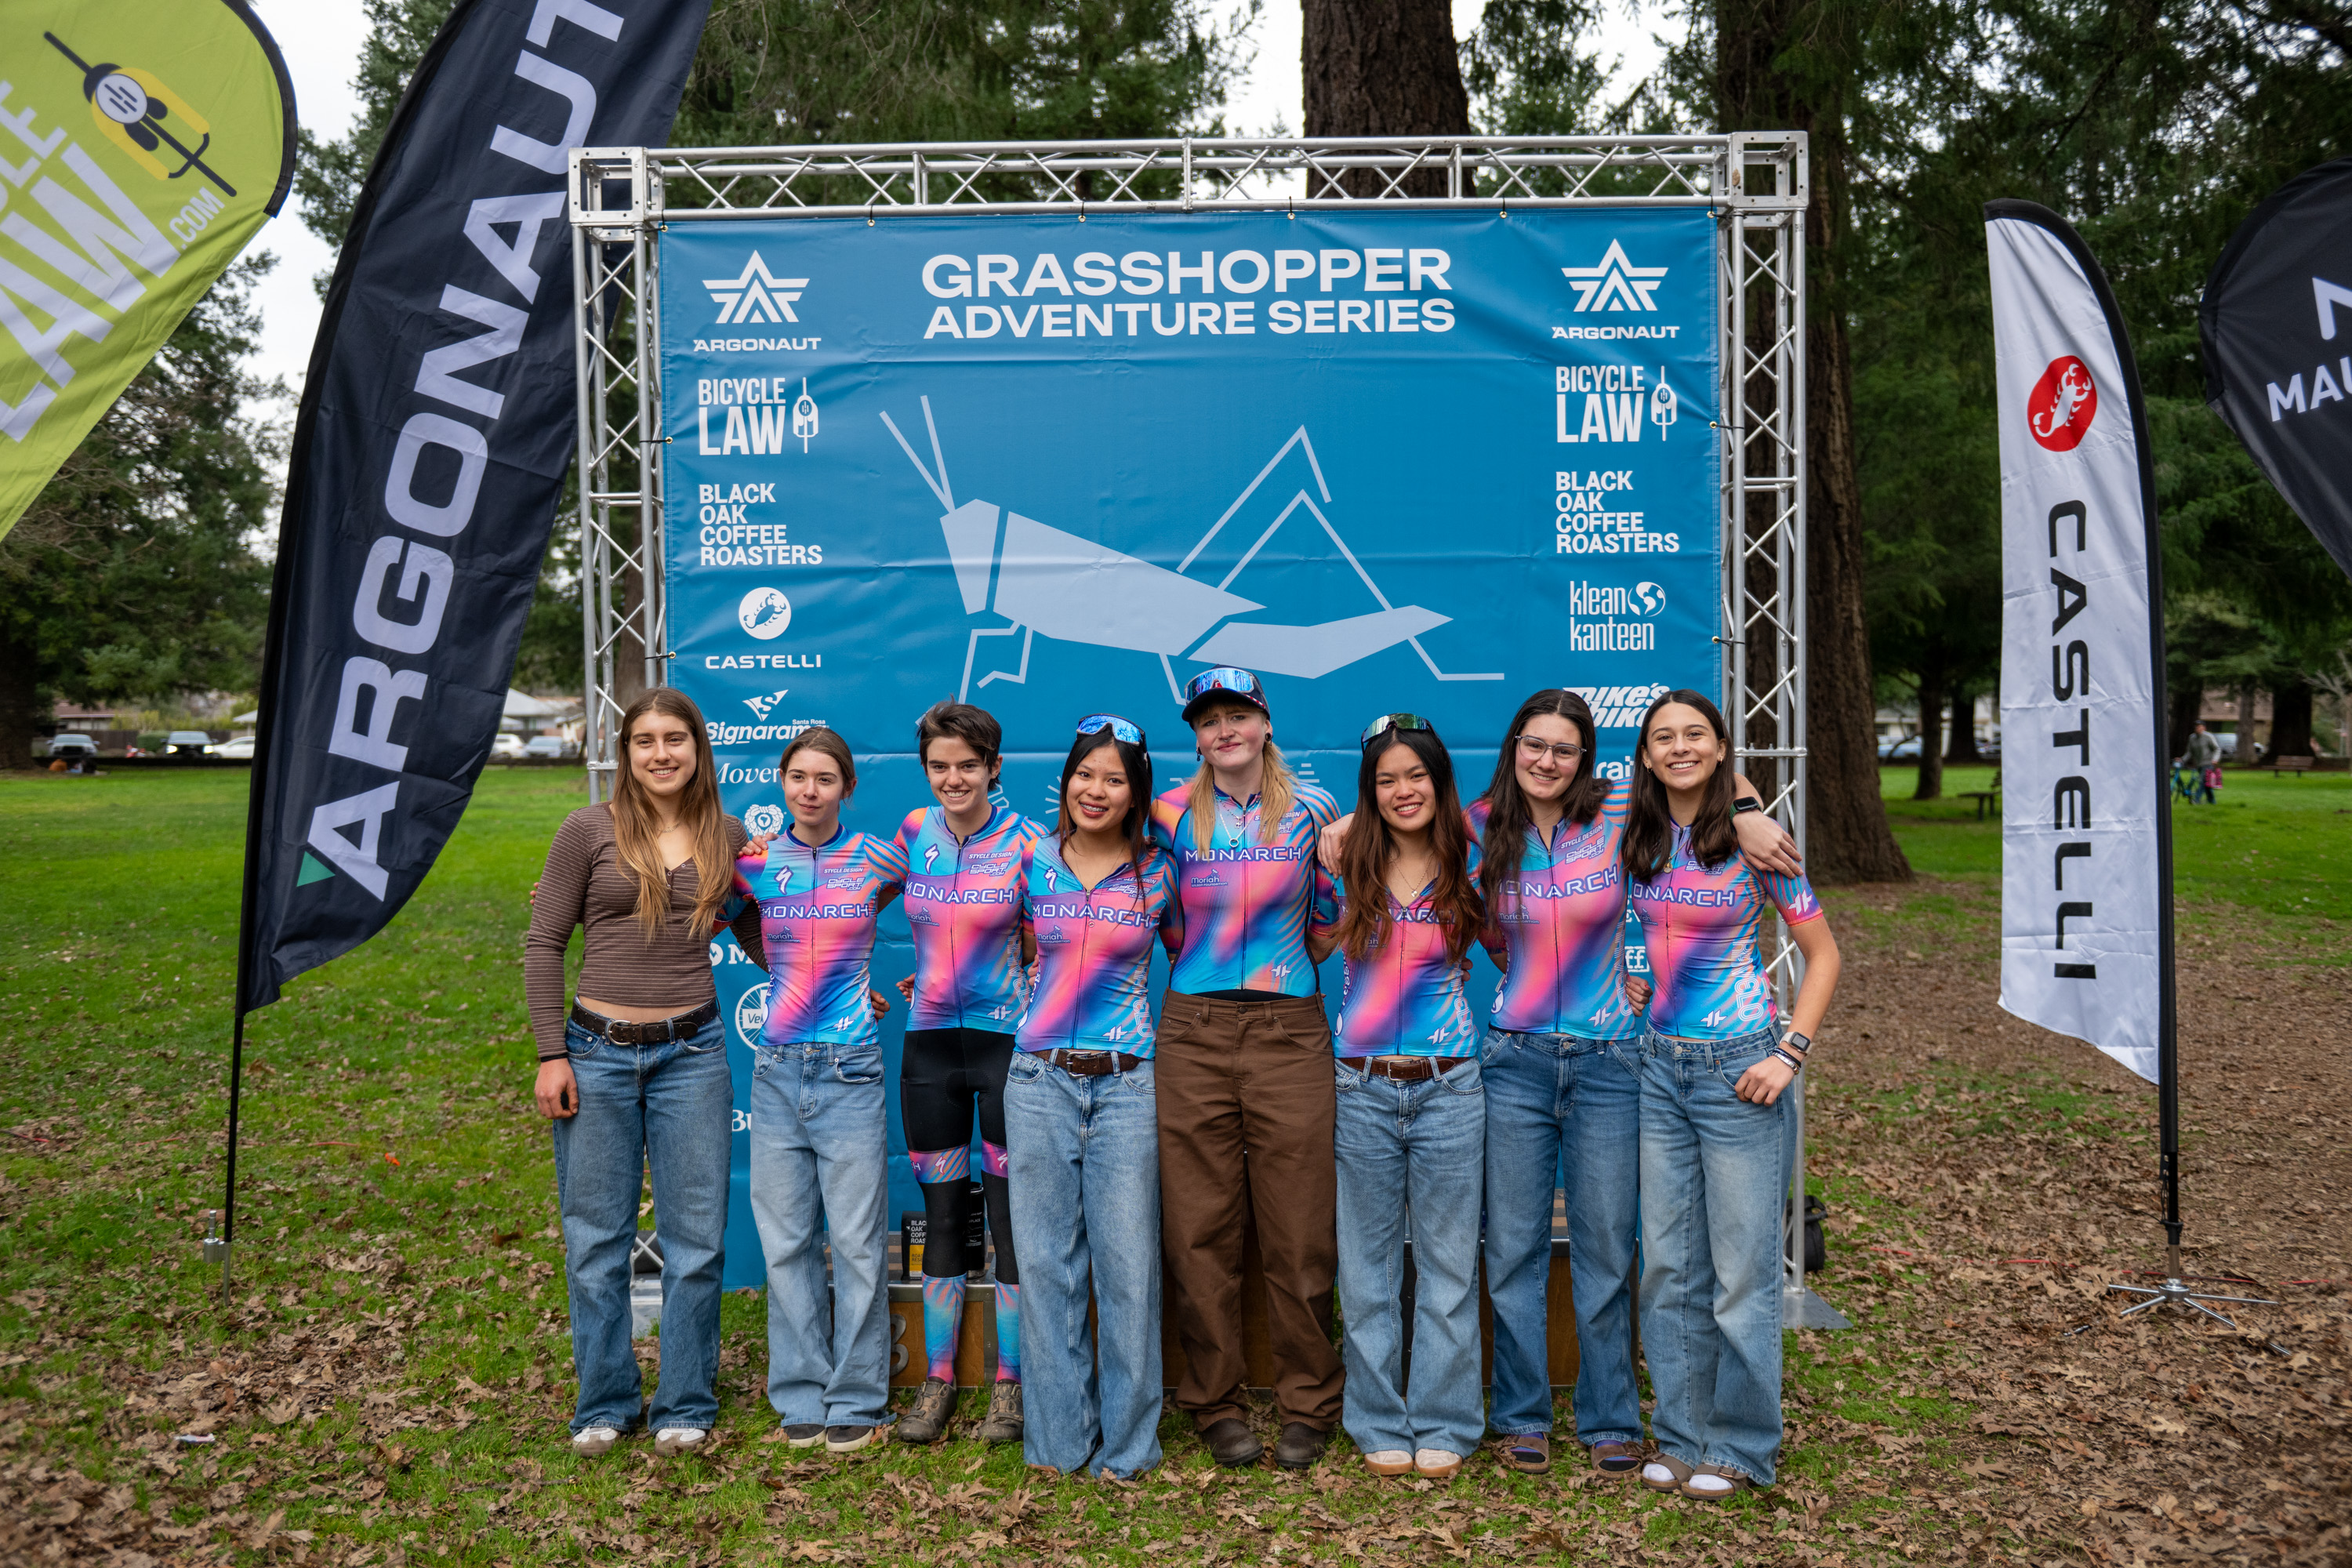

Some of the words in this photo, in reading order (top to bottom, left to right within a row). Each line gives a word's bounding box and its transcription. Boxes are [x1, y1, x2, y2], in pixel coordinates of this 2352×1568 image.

[169, 187, 225, 250] .COM
[921, 248, 1453, 299] GRASSHOPPER
[923, 301, 1256, 339] ADVENTURE
[1268, 298, 1455, 334] SERIES
[1552, 325, 1680, 339] ARGONAUT
[693, 337, 822, 352] ARGONAUT
[1555, 365, 1645, 392] BICYCLE
[698, 377, 786, 406] BICYCLE
[1556, 394, 1644, 443] LAW
[699, 405, 786, 456] LAW
[1555, 470, 1634, 491] BLACK
[699, 483, 777, 504] BLACK
[1555, 492, 1605, 512] OAK
[699, 504, 749, 524] OAK
[1555, 512, 1644, 533] COFFEE
[700, 524, 787, 545] COFFEE
[1556, 532, 1679, 554] ROASTERS
[700, 544, 823, 566] ROASTERS
[1570, 580, 1626, 615] klean
[1570, 616, 1654, 652] kanteen
[706, 654, 822, 670] CASTELLI
[706, 721, 827, 746] Signaram
[2047, 499, 2096, 980] CASTELLI
[1561, 836, 1582, 849] STYCLE
[1582, 825, 1603, 840] DESIGN
[906, 881, 1013, 902] MONARCH
[1632, 885, 1734, 906] ONARCH
[761, 905, 869, 918] MONARCH
[1033, 904, 1150, 927] MONARCH
